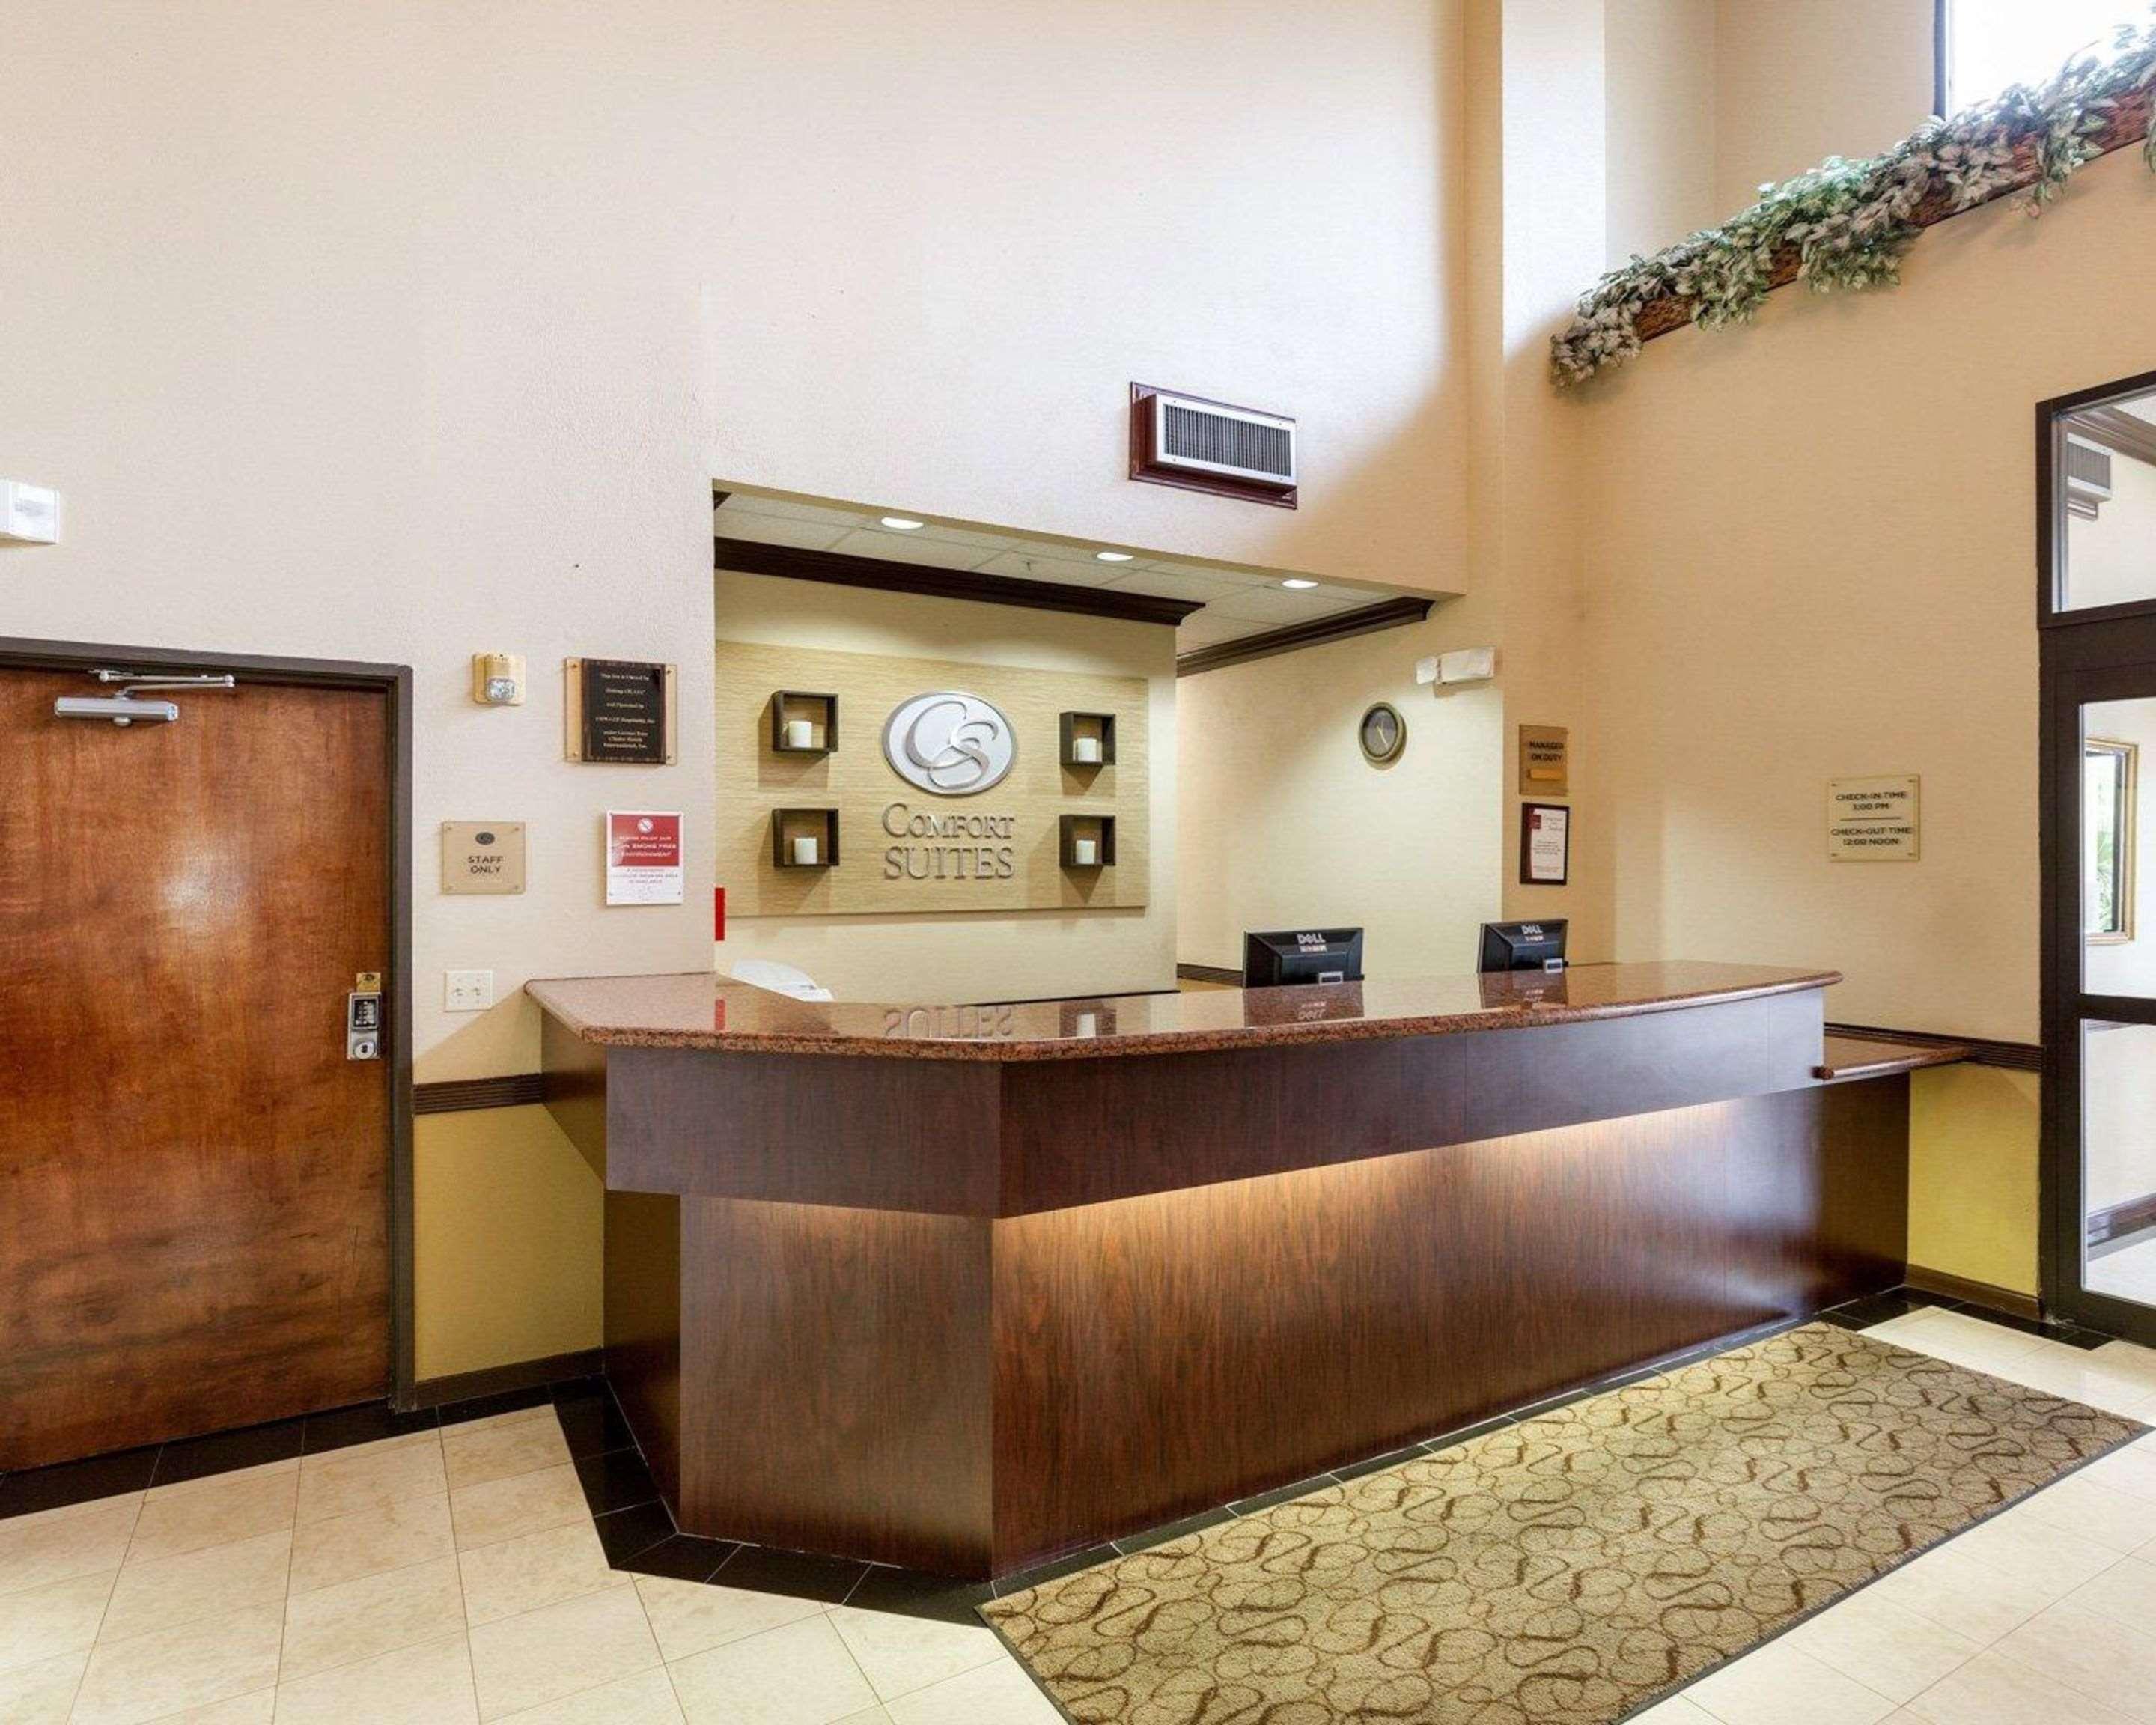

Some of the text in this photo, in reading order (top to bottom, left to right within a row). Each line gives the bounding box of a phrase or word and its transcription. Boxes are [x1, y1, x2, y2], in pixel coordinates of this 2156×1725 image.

[1835, 793, 1881, 801] CHECK-IN
[1830, 827, 1914, 836] CHECK-OUT TIME
[467, 855, 505, 863] STAFF
[883, 845, 1016, 880] SUITES
[470, 865, 502, 874] ONLY
[1521, 925, 1544, 936] DELL
[1297, 932, 1327, 945] DELL
